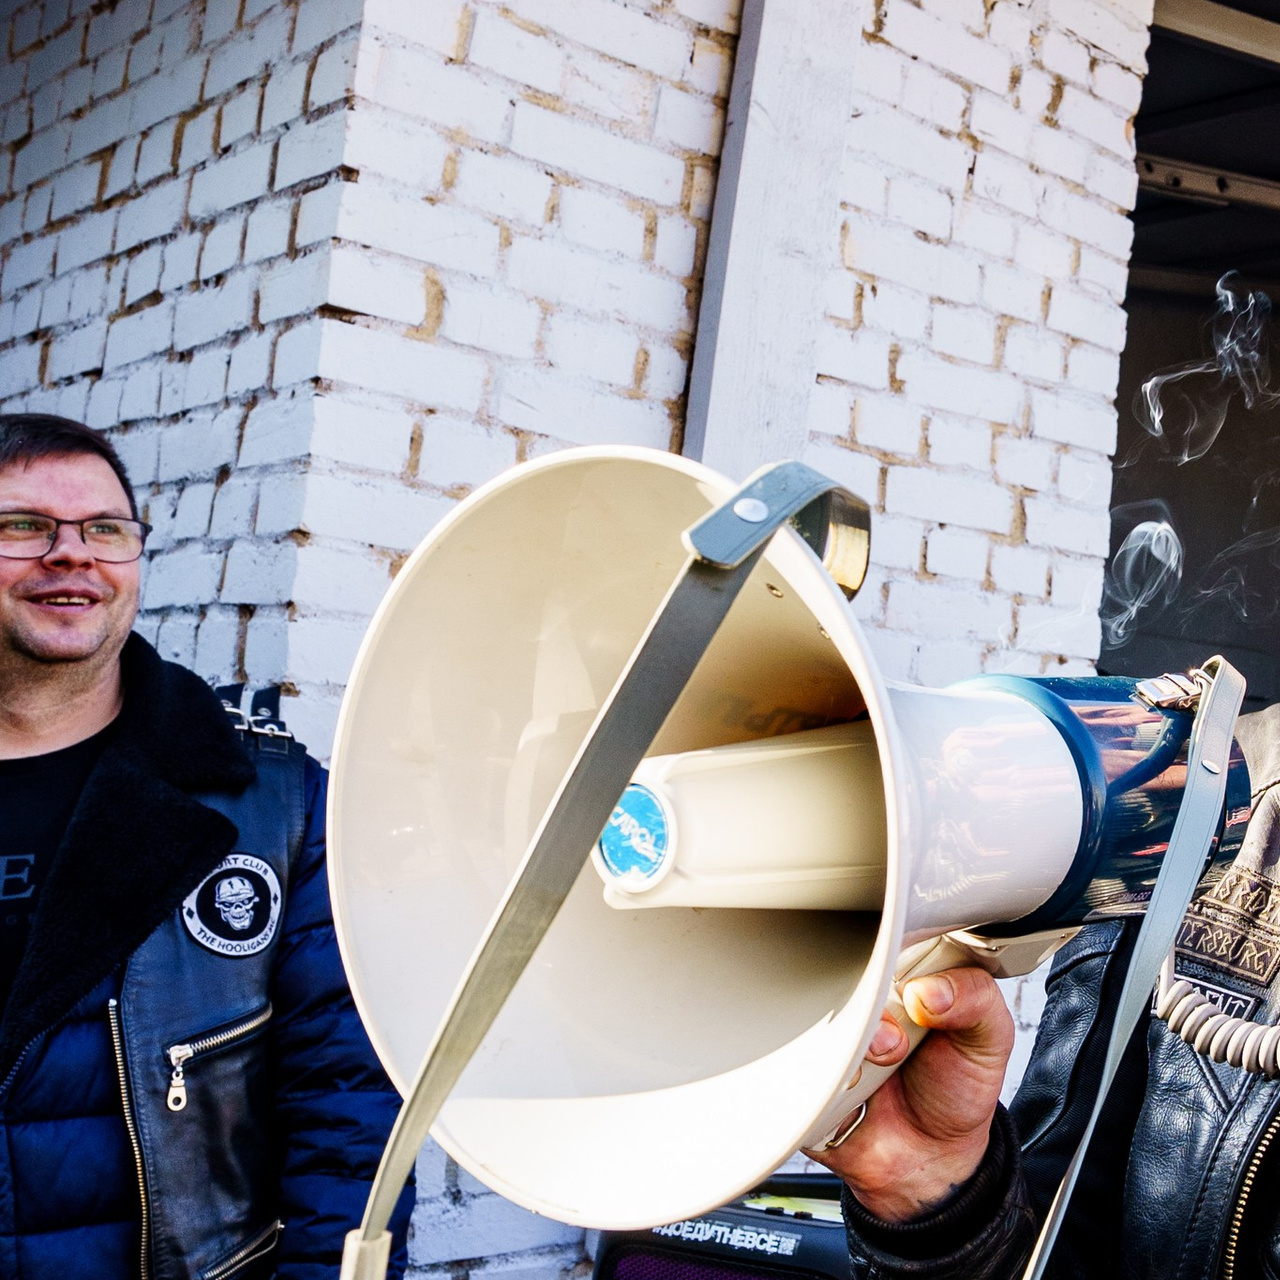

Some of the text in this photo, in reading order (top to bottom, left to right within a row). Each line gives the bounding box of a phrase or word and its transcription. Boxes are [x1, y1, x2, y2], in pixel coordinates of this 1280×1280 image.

[243, 858, 269, 876] CLUB
[196, 927, 216, 946] THE
[1176, 919, 1271, 975] TERSBURG
